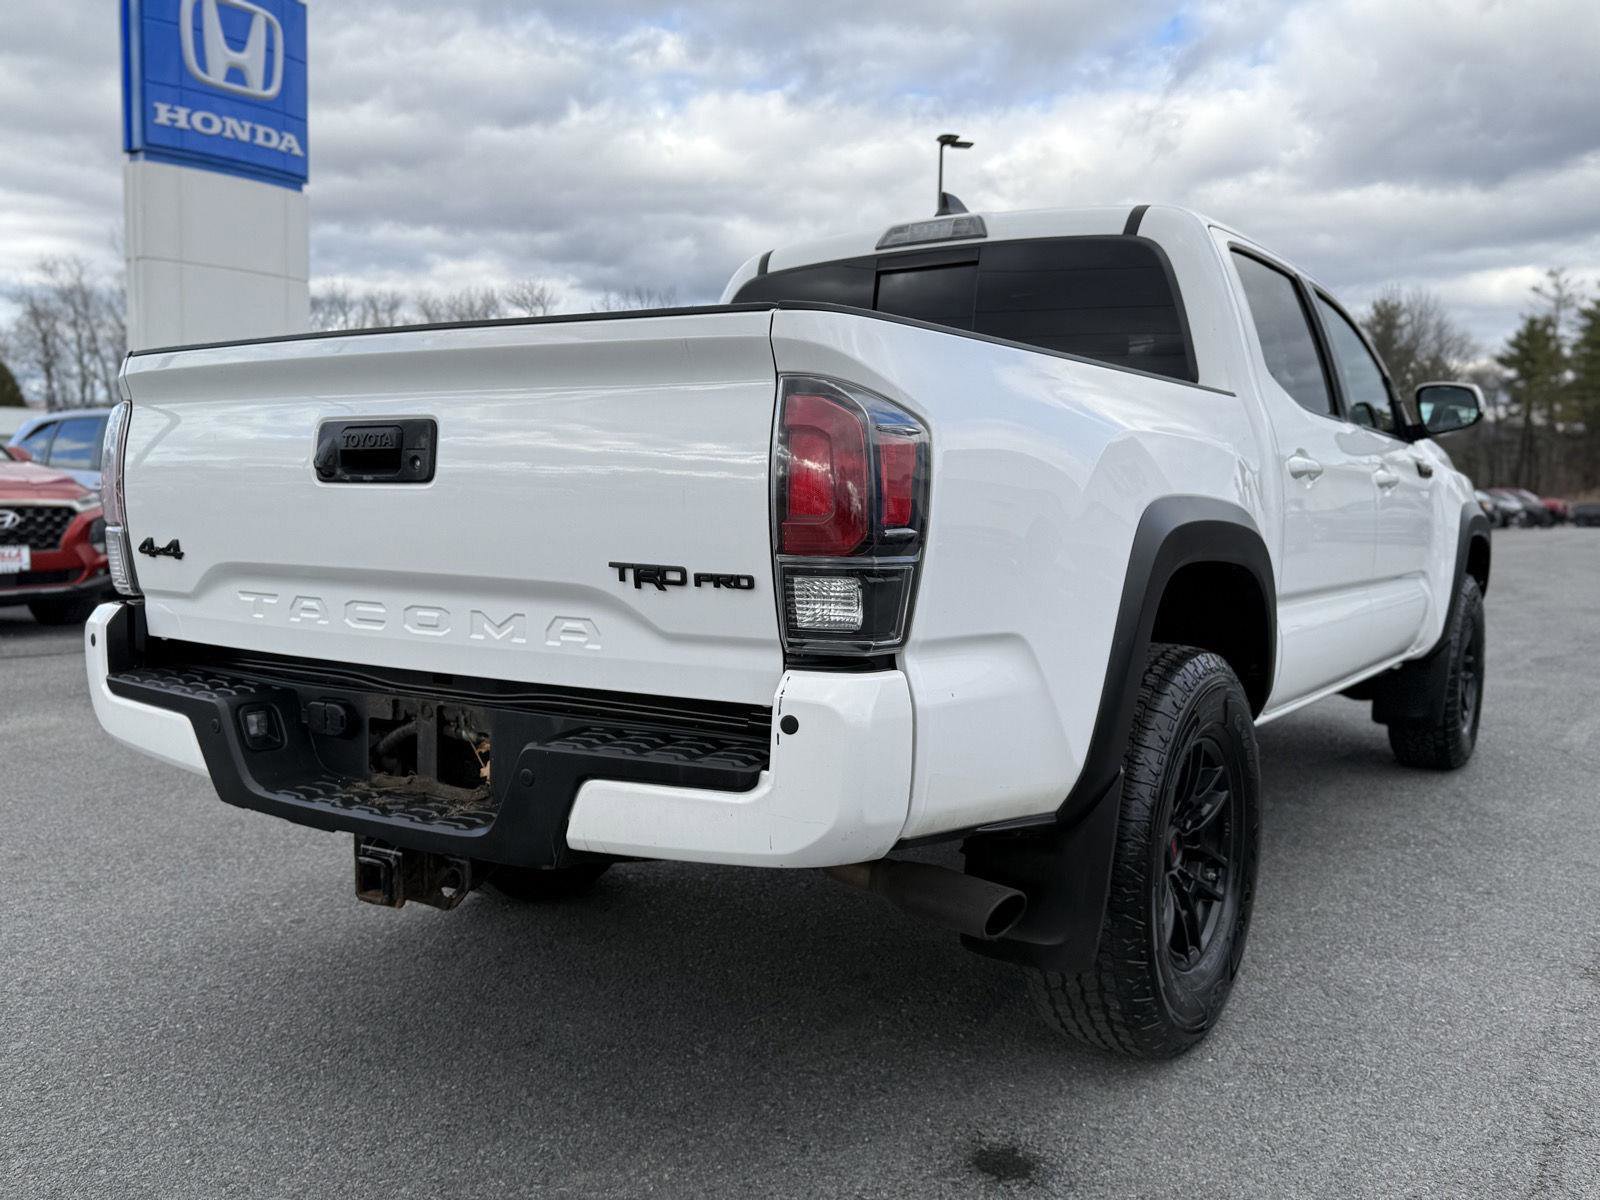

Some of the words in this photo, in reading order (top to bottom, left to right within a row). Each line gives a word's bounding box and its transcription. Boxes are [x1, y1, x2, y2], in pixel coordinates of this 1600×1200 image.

[153, 102, 304, 157] HONDA
[342, 432, 394, 448] TOYOTA
[608, 561, 688, 592] TRD
[693, 572, 755, 590] PRO
[238, 590, 601, 650] TACOMA
